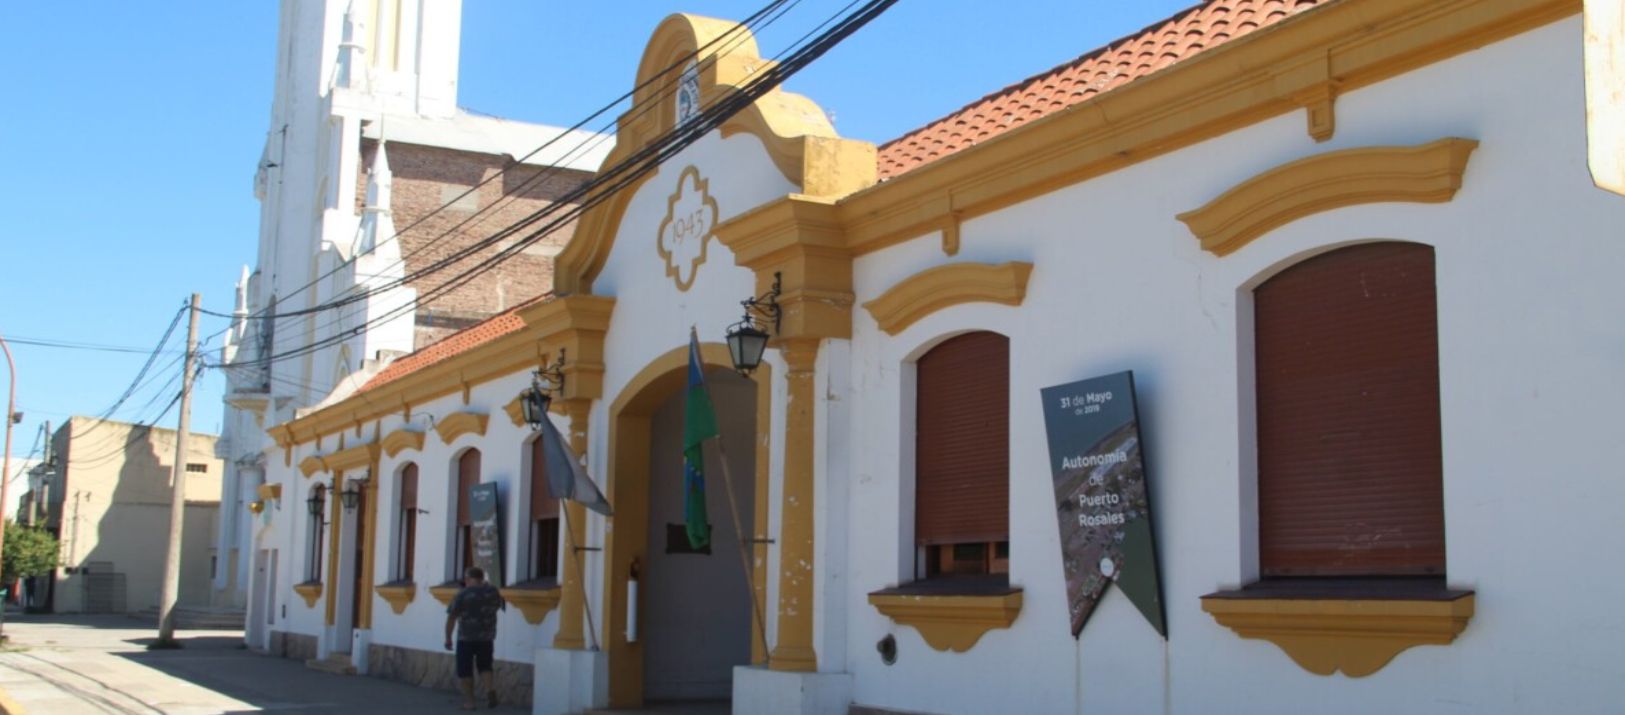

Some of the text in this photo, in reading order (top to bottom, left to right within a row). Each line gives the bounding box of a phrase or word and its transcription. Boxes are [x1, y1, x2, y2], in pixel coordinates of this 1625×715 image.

[672, 208, 704, 245] 1943
[1060, 391, 1113, 409] 31 de Mayo
[1062, 449, 1128, 470] Autonomía
[1089, 474, 1105, 486] de
[1079, 493, 1120, 507] Puerto
[1079, 511, 1125, 527] Rosales
